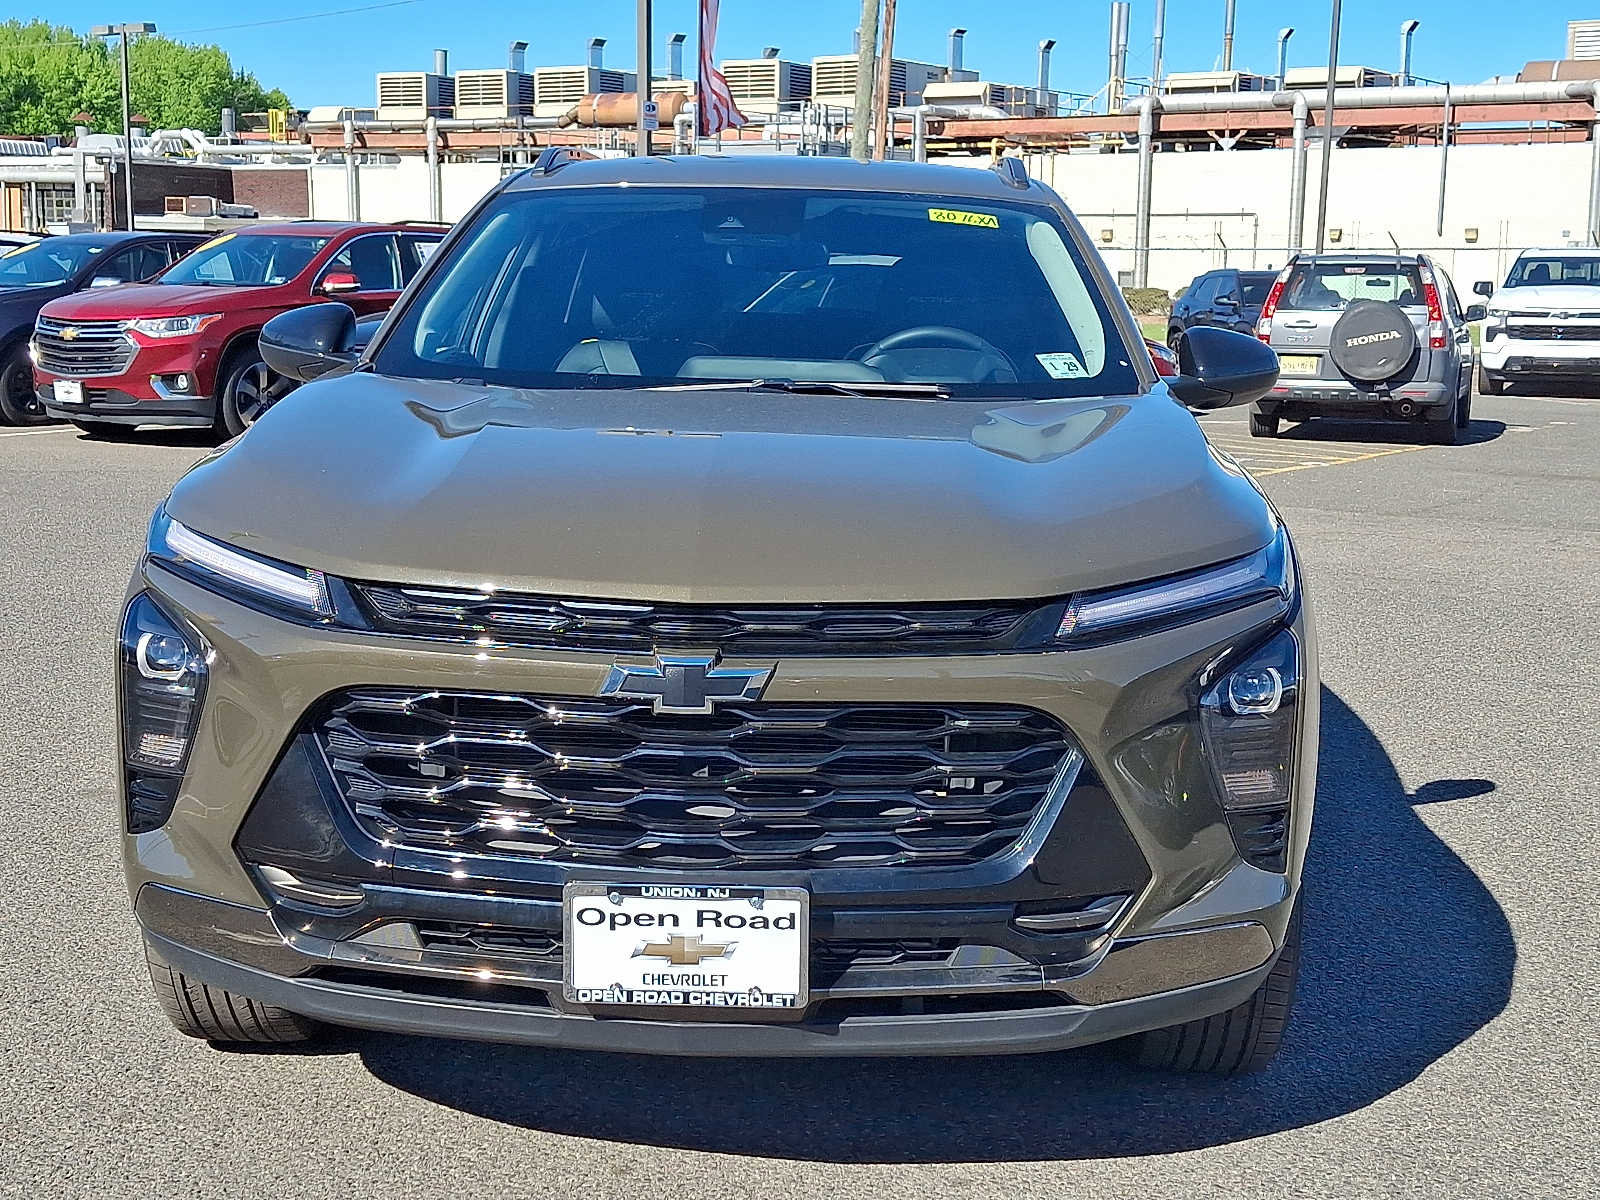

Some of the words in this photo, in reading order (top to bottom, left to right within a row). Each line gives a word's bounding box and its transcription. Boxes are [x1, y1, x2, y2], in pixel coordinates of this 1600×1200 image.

[1346, 330, 1401, 348] HONDA
[1063, 361, 1079, 372] 29
[641, 886, 701, 898] UNION,
[707, 887, 730, 898] NJ
[576, 907, 680, 931] Open
[696, 909, 796, 930] Road
[642, 973, 728, 987] CHEVROLET
[577, 989, 628, 1003] OPEN
[632, 991, 684, 1005] ROAD
[688, 991, 796, 1007] CHEVROLET
